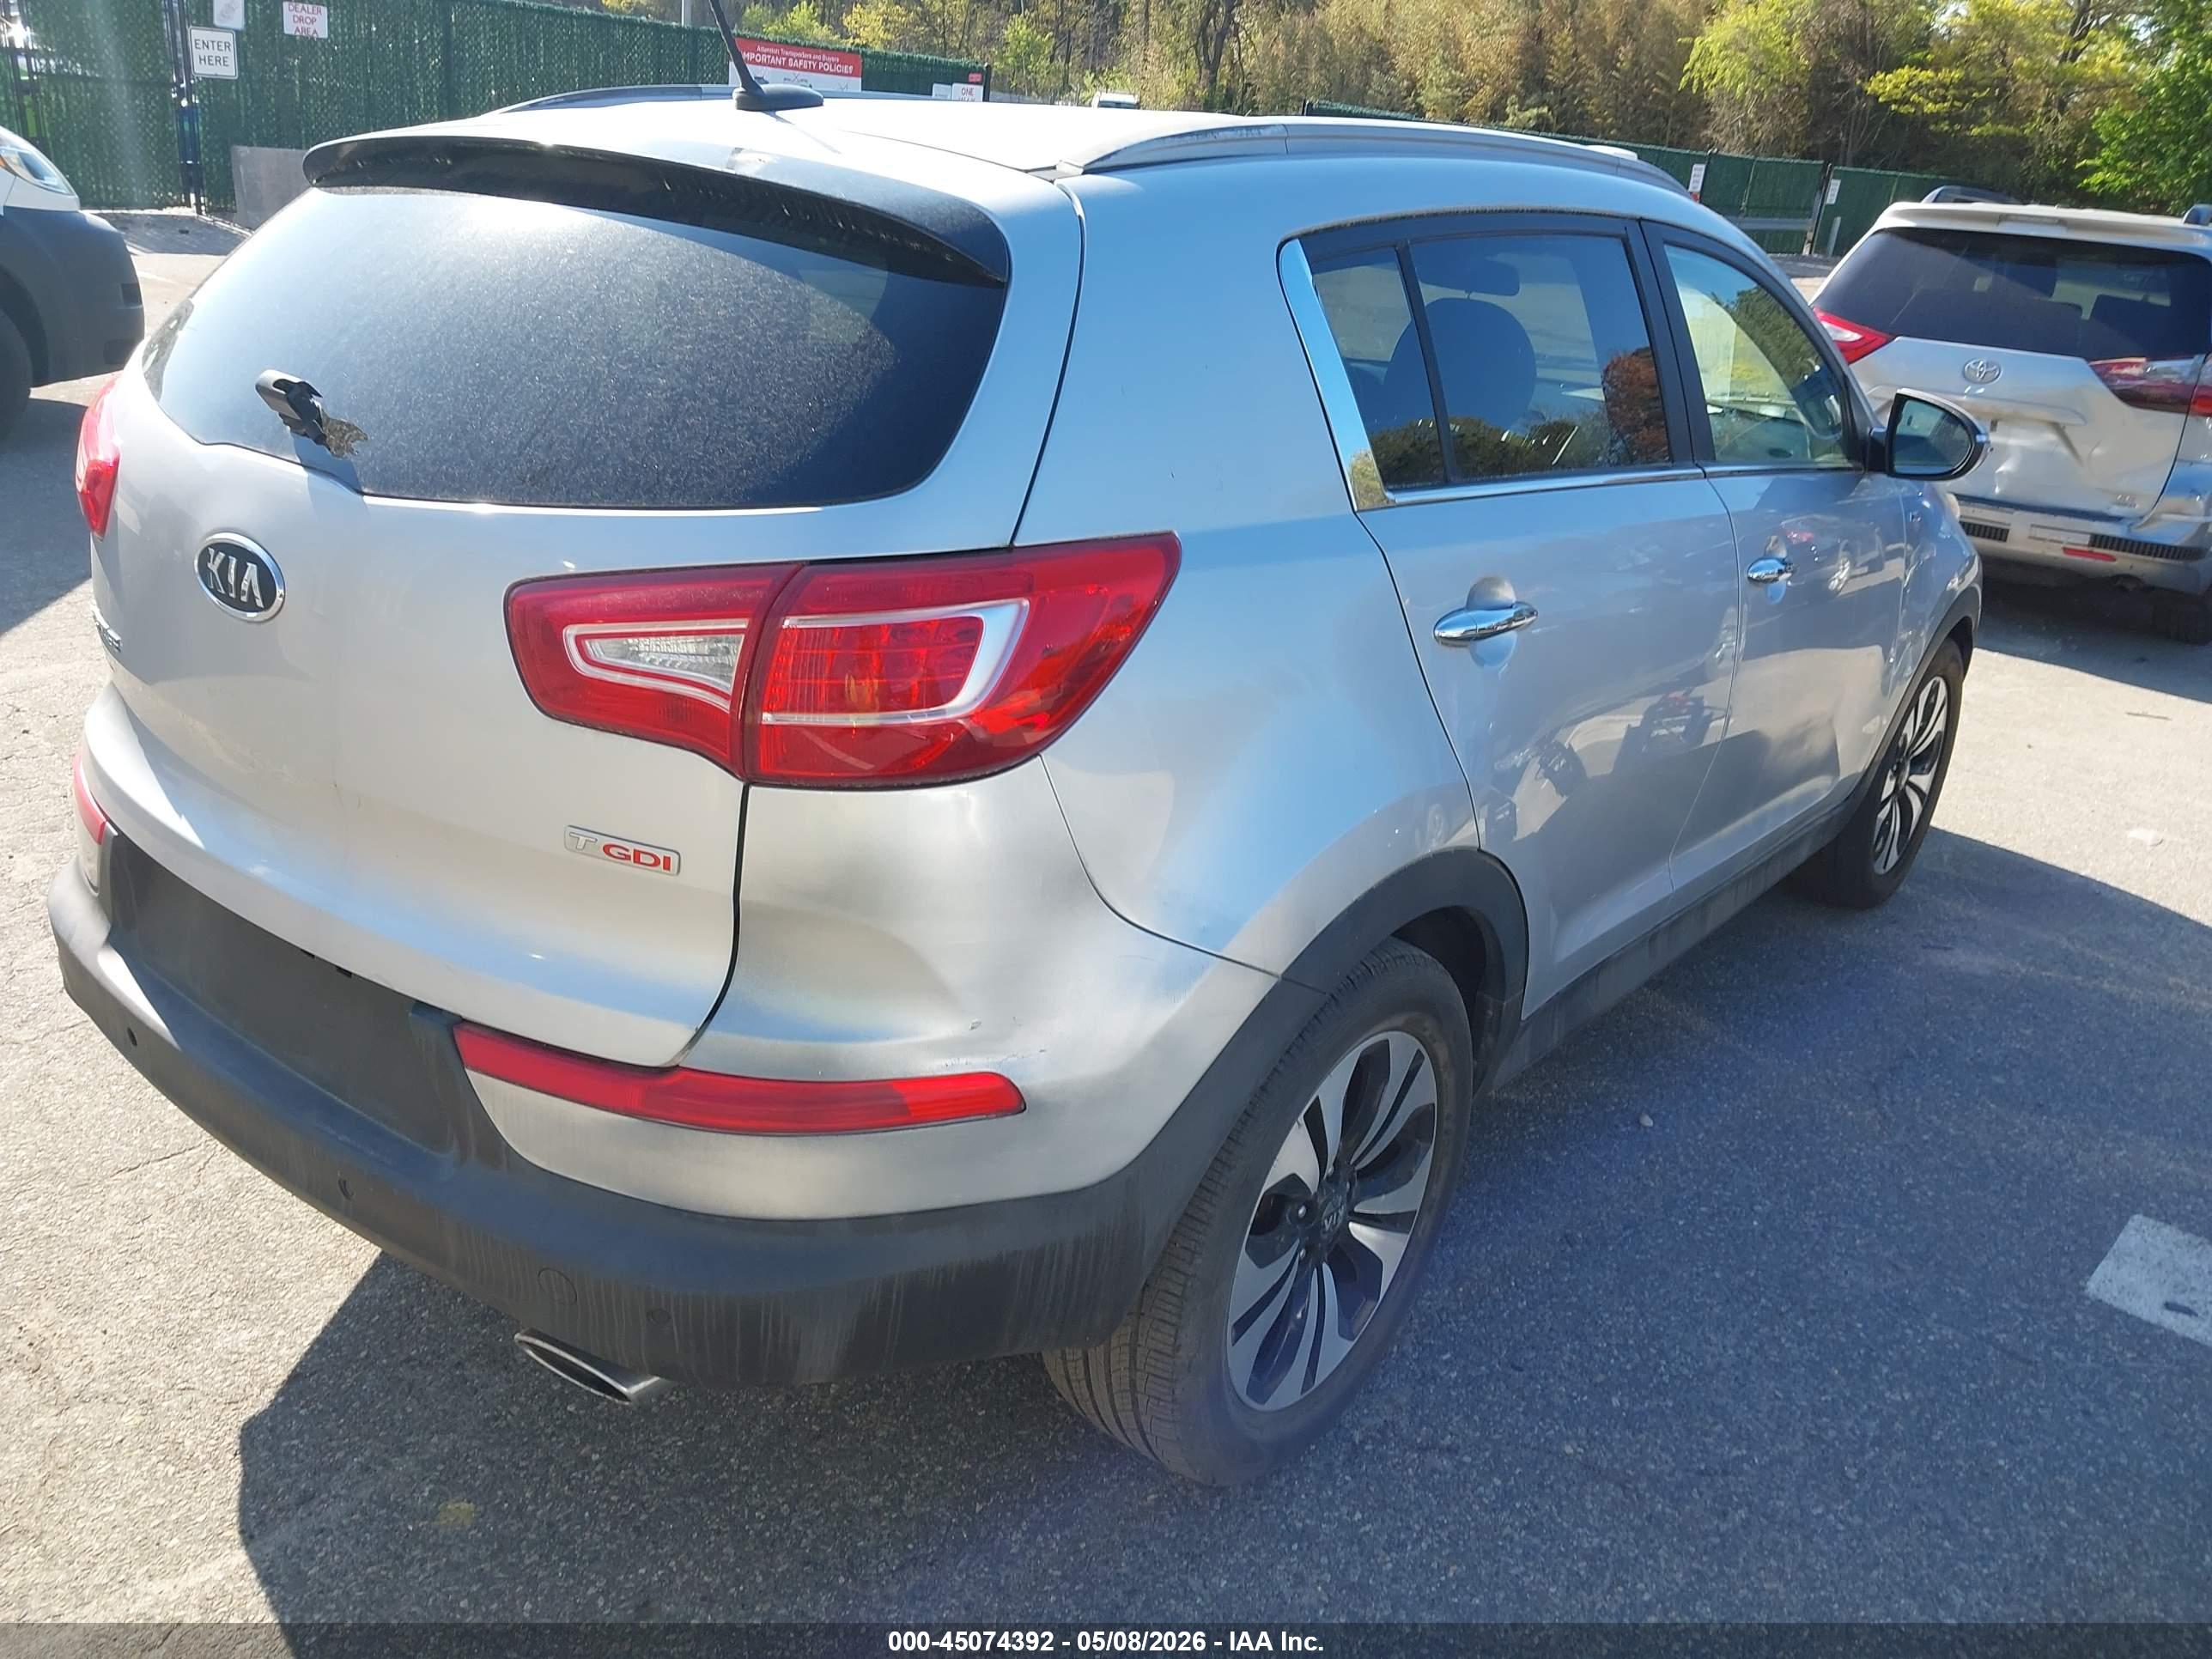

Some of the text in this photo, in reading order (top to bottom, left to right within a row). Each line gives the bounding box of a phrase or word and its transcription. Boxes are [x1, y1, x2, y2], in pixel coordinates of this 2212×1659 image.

[288, 3, 322, 15] DEALER
[293, 15, 317, 26] DROP
[294, 27, 319, 37] AREA
[194, 39, 231, 52] ENTER
[199, 55, 229, 67] HERE
[742, 51, 854, 75] MPORTANT SAFETY POLICIES
[961, 87, 975, 97] ONE
[207, 547, 264, 609] KIA
[569, 832, 672, 872] T GDI
